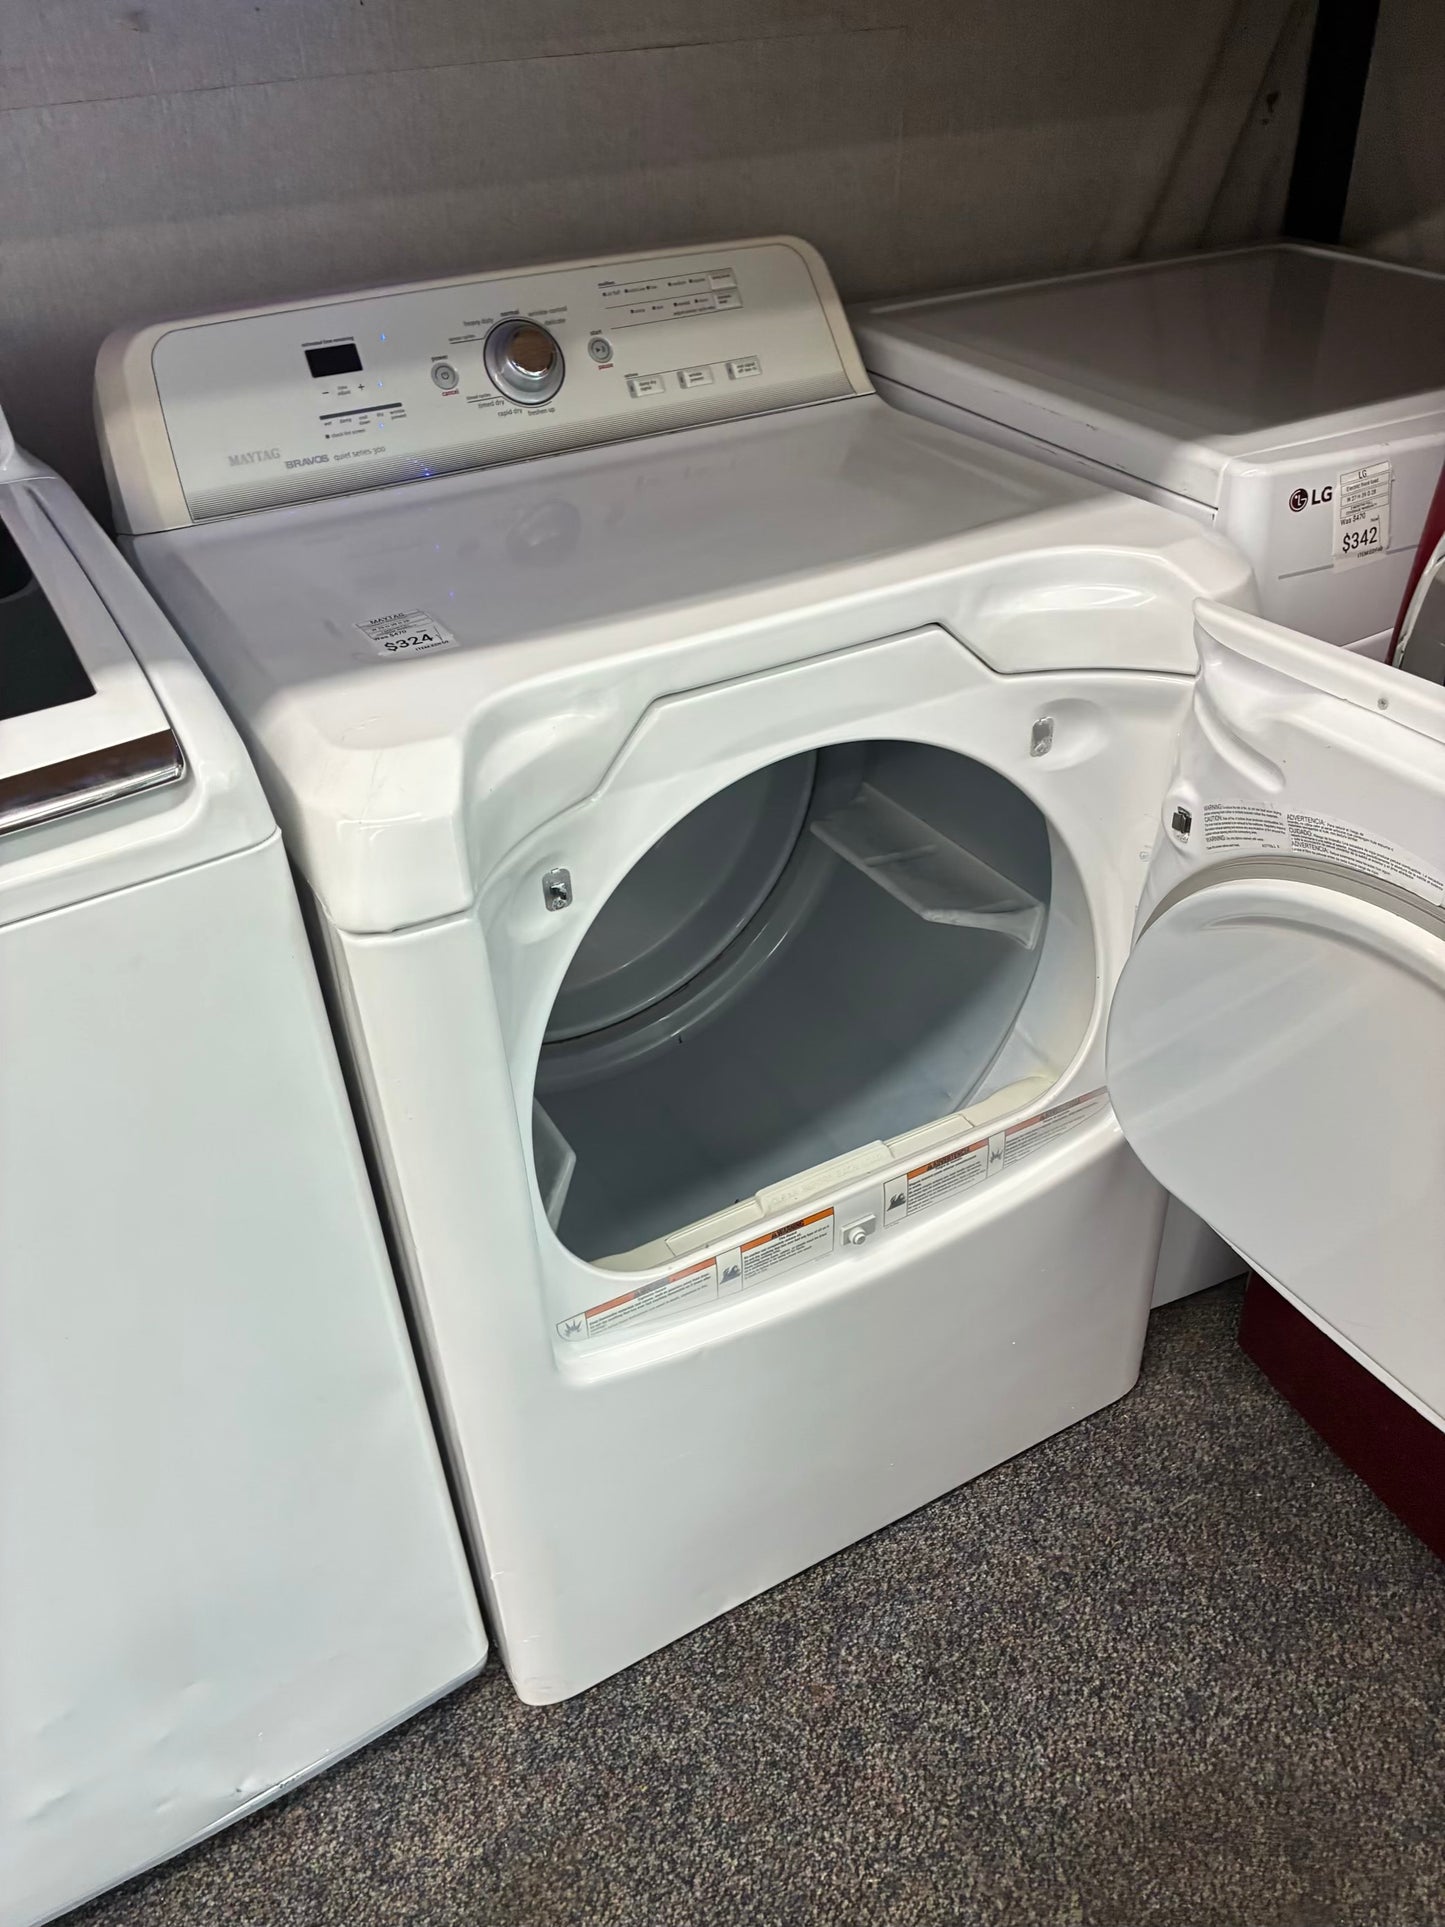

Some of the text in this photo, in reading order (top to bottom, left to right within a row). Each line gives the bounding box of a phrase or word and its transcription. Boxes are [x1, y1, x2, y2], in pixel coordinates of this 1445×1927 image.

[495, 399, 504, 407] dry
[528, 408, 547, 416] freshen
[228, 448, 281, 466] MAYTAG
[285, 446, 386, 469] BRAVOS quiet series 300
[1358, 470, 1367, 479] LG
[1312, 486, 1332, 505] LG
[1353, 513, 1366, 522] $470
[1342, 526, 1377, 553] $342
[370, 613, 405, 625] MAYTAG
[384, 634, 433, 651] $324
